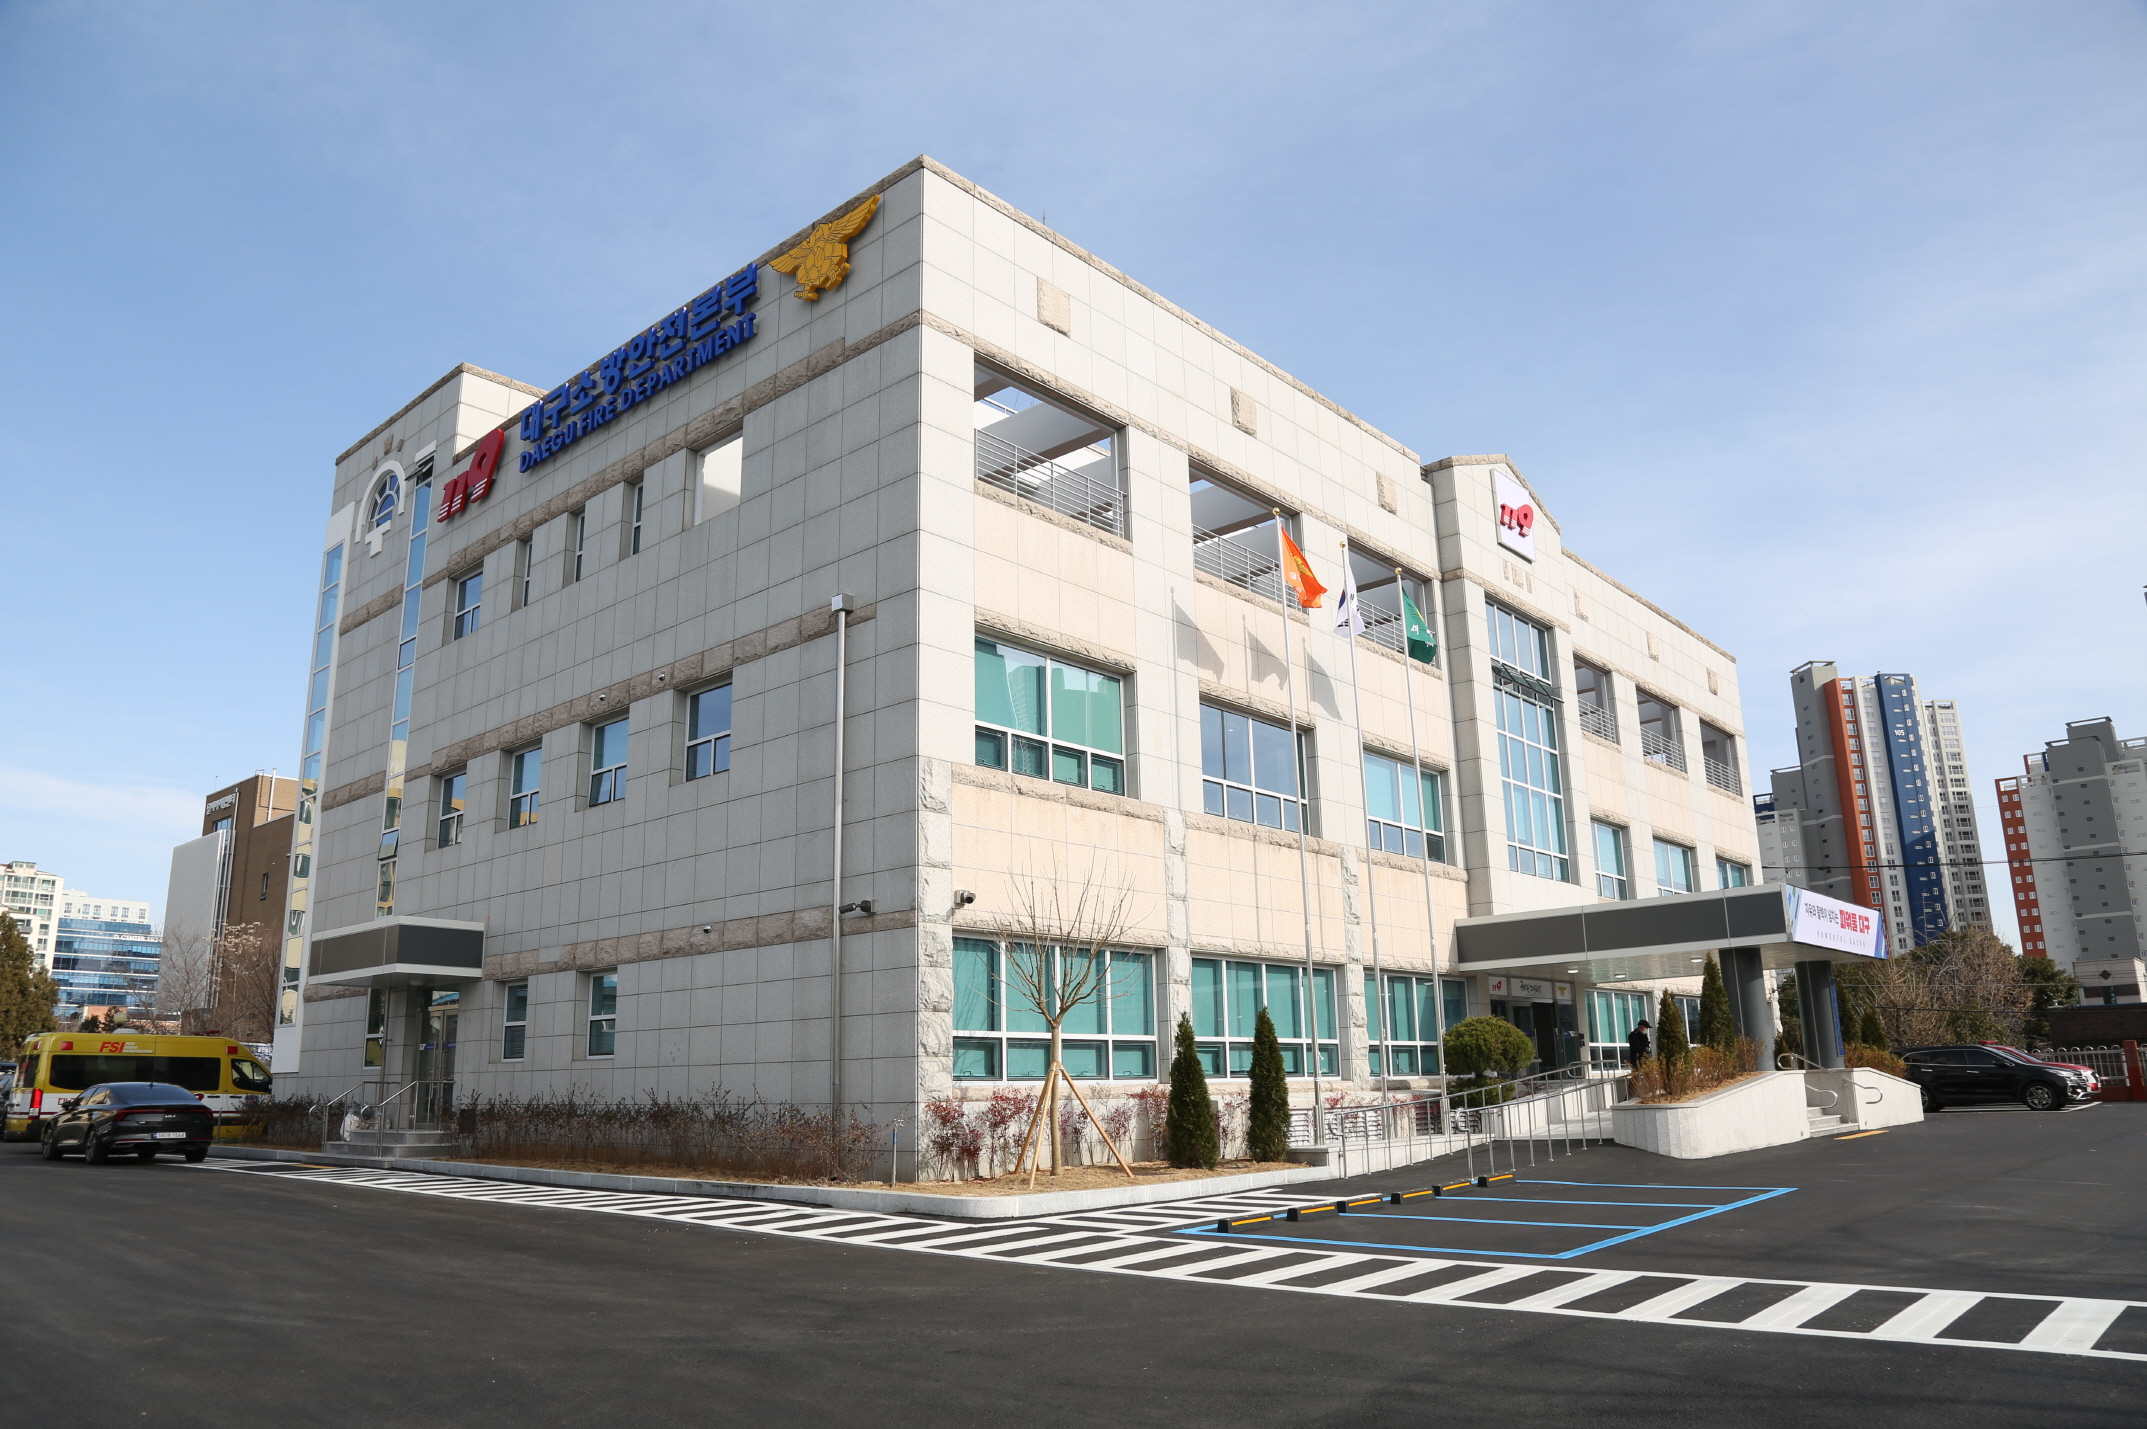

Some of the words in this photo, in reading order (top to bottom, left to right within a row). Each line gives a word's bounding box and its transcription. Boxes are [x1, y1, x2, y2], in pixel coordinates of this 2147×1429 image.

[520, 263, 758, 443] 대구소방안전본부
[519, 420, 578, 473] DAEGU
[579, 394, 618, 436] FIRE
[619, 313, 757, 412] DEPARTMENT
[437, 428, 504, 522] 119
[1500, 503, 1534, 537] 119
[1817, 931, 1846, 943] POWERFUL
[1849, 938, 1865, 947] DAEGU
[1839, 909, 1858, 932] 파워풀
[1858, 915, 1870, 935] 대구
[99, 1042, 126, 1053] FSI
